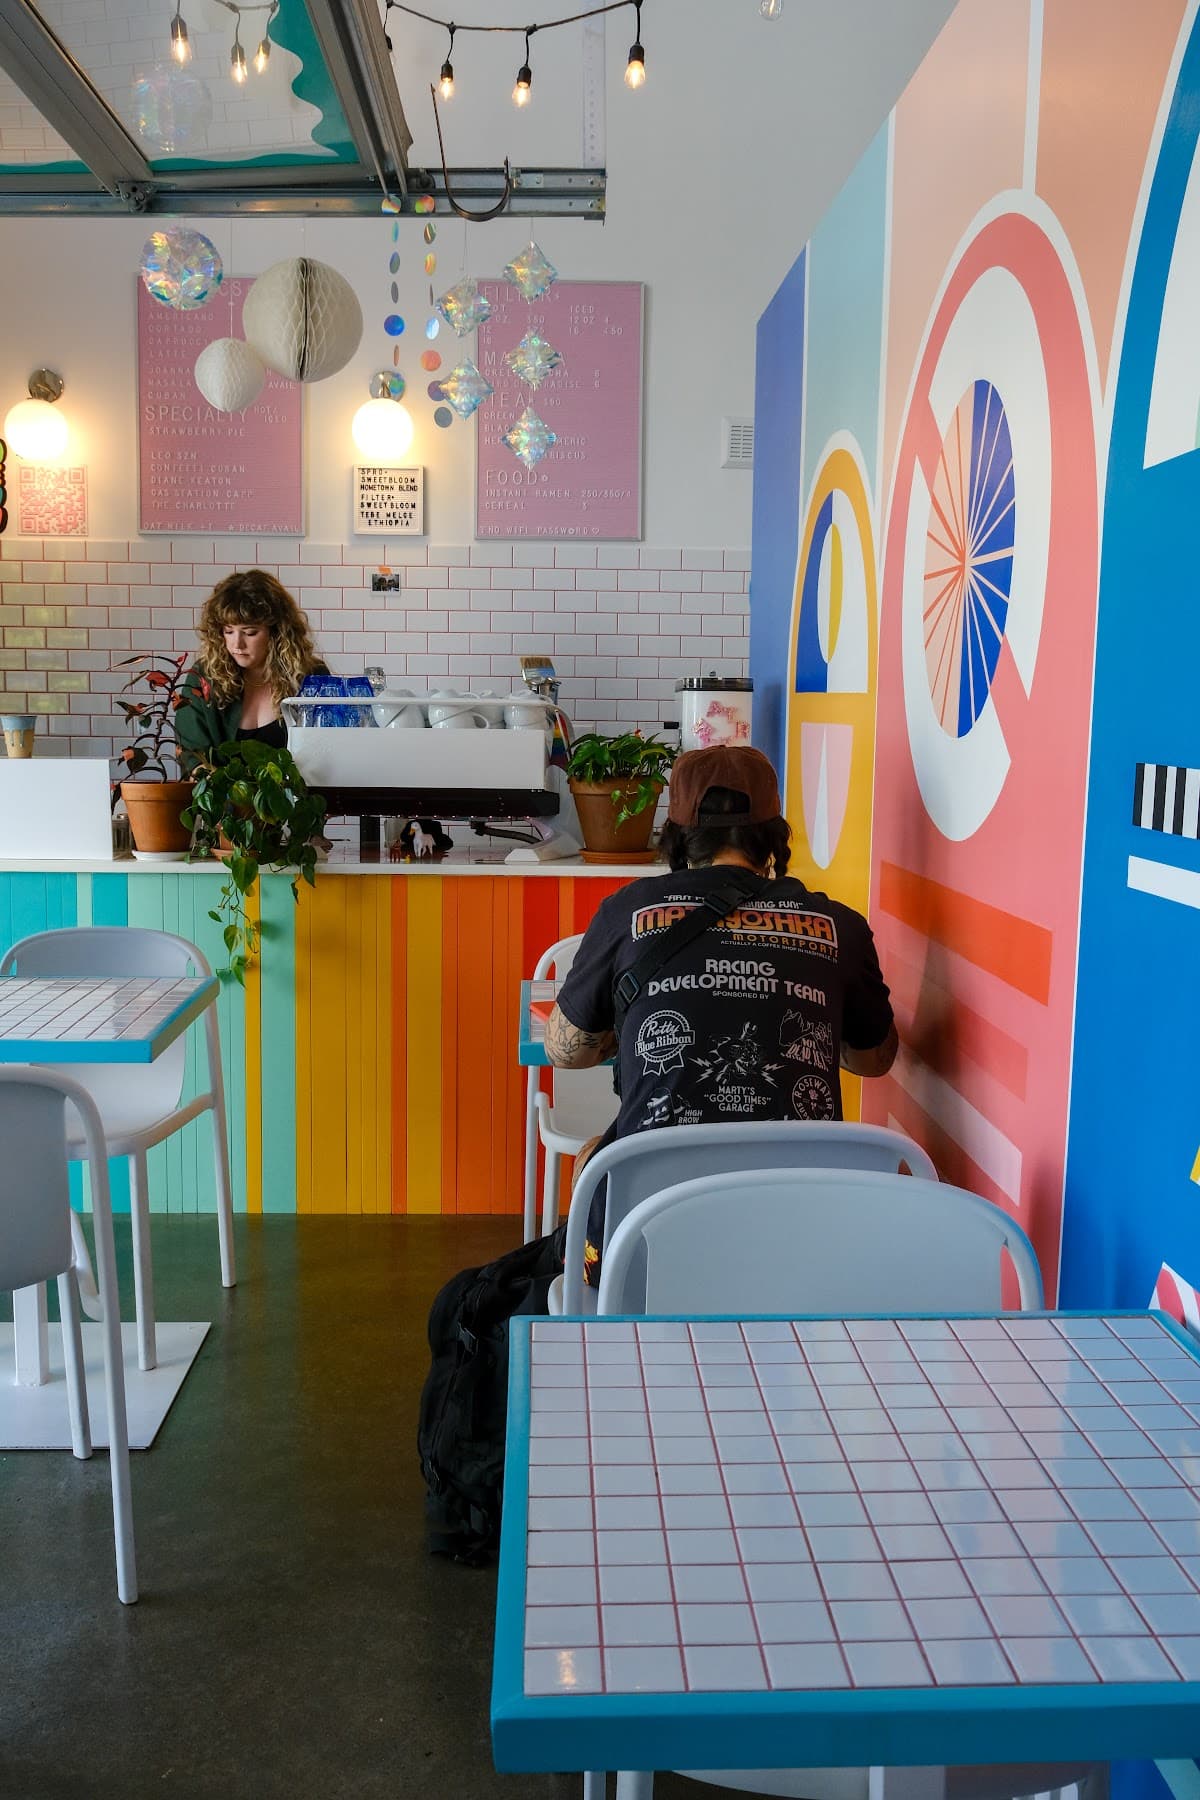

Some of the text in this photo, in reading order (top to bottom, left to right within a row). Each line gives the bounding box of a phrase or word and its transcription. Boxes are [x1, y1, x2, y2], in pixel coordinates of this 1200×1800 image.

[569, 304, 594, 314] ICED
[148, 312, 214, 321] AMERICANO
[148, 324, 202, 333] CORTADO
[150, 350, 187, 359] LATTE
[147, 391, 186, 400] CUBAN
[484, 411, 515, 420] GREEN
[149, 426, 247, 437] STRAWBERRY PIE
[151, 451, 171, 460] LEO
[150, 463, 246, 473] CONFETTI CUBAN
[151, 476, 231, 485] DIANE KEATON
[485, 470, 538, 486] FOOD
[360, 484, 418, 492] HOMETOWN BLEND
[175, 489, 219, 498] STATION
[486, 489, 527, 498] INSTANT
[535, 489, 571, 498] RAMEN
[151, 500, 235, 510] THE CHARLOTTE
[485, 501, 525, 511] CEREAL
[143, 521, 161, 530] OAT
[168, 522, 192, 530] MILK
[368, 519, 410, 527] ETHIOPIA
[488, 526, 500, 536] NO
[506, 526, 528, 536] WIFI
[757, 941, 780, 949] COFFEE
[705, 958, 776, 976] RACING
[648, 974, 826, 1006] DEVELOPMENT TEAM
[712, 990, 757, 1000] SPONSORED
[637, 1033, 692, 1054] Blue Ribbon
[718, 1085, 756, 1096] MARTY'S
[794, 1077, 833, 1110] ROSEWATER
[703, 1093, 772, 1106] "GOOD TIMES"
[718, 1102, 755, 1113] GARAGE
[684, 1109, 703, 1117] HIGH
[678, 1116, 700, 1124] BROW
